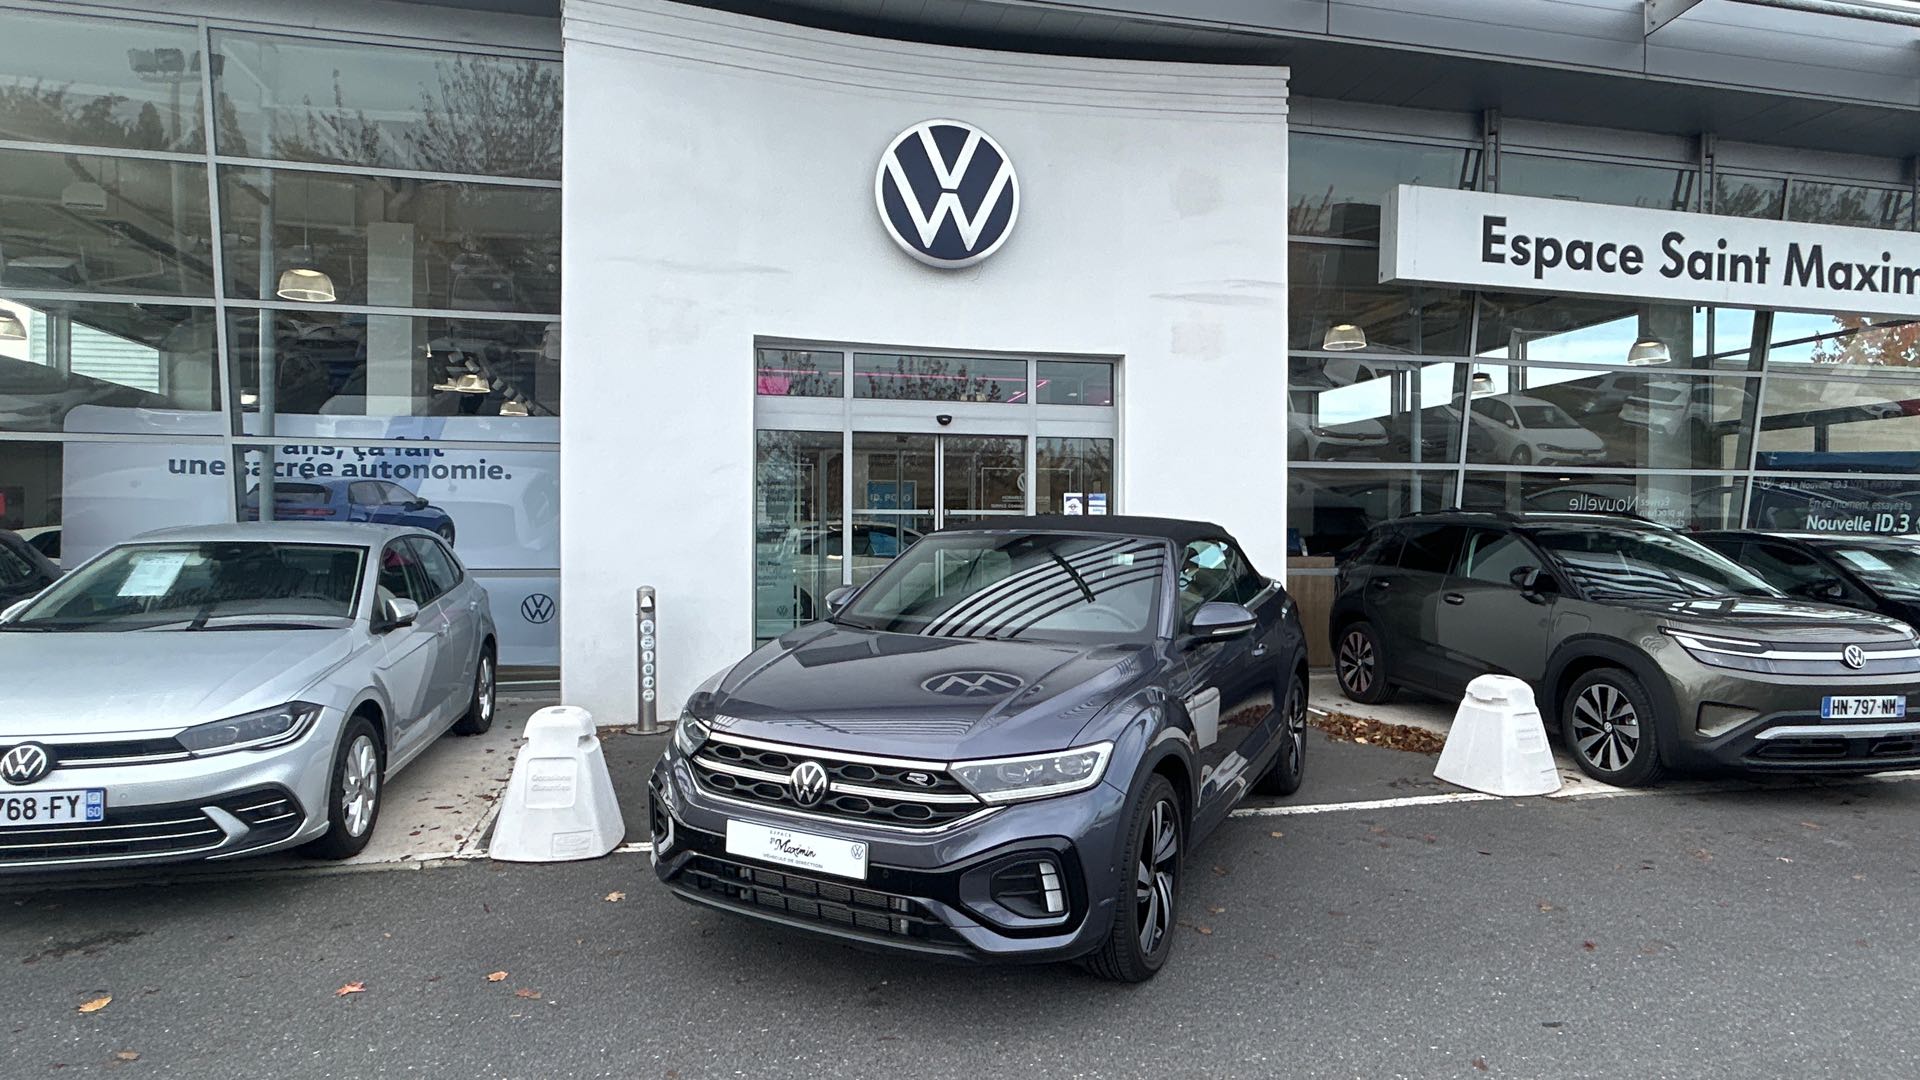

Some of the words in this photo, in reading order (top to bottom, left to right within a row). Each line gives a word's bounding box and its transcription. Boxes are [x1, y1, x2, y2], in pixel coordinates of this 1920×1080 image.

[1482, 215, 1644, 279] Espace
[1659, 231, 1771, 285] Saint
[1783, 242, 1920, 296] Maxim
[168, 459, 226, 475] une
[341, 458, 512, 480] autonomie.
[1806, 514, 1872, 532] Nouvelle
[1874, 513, 1910, 533] ID.3
[87, 806, 101, 818] 60
